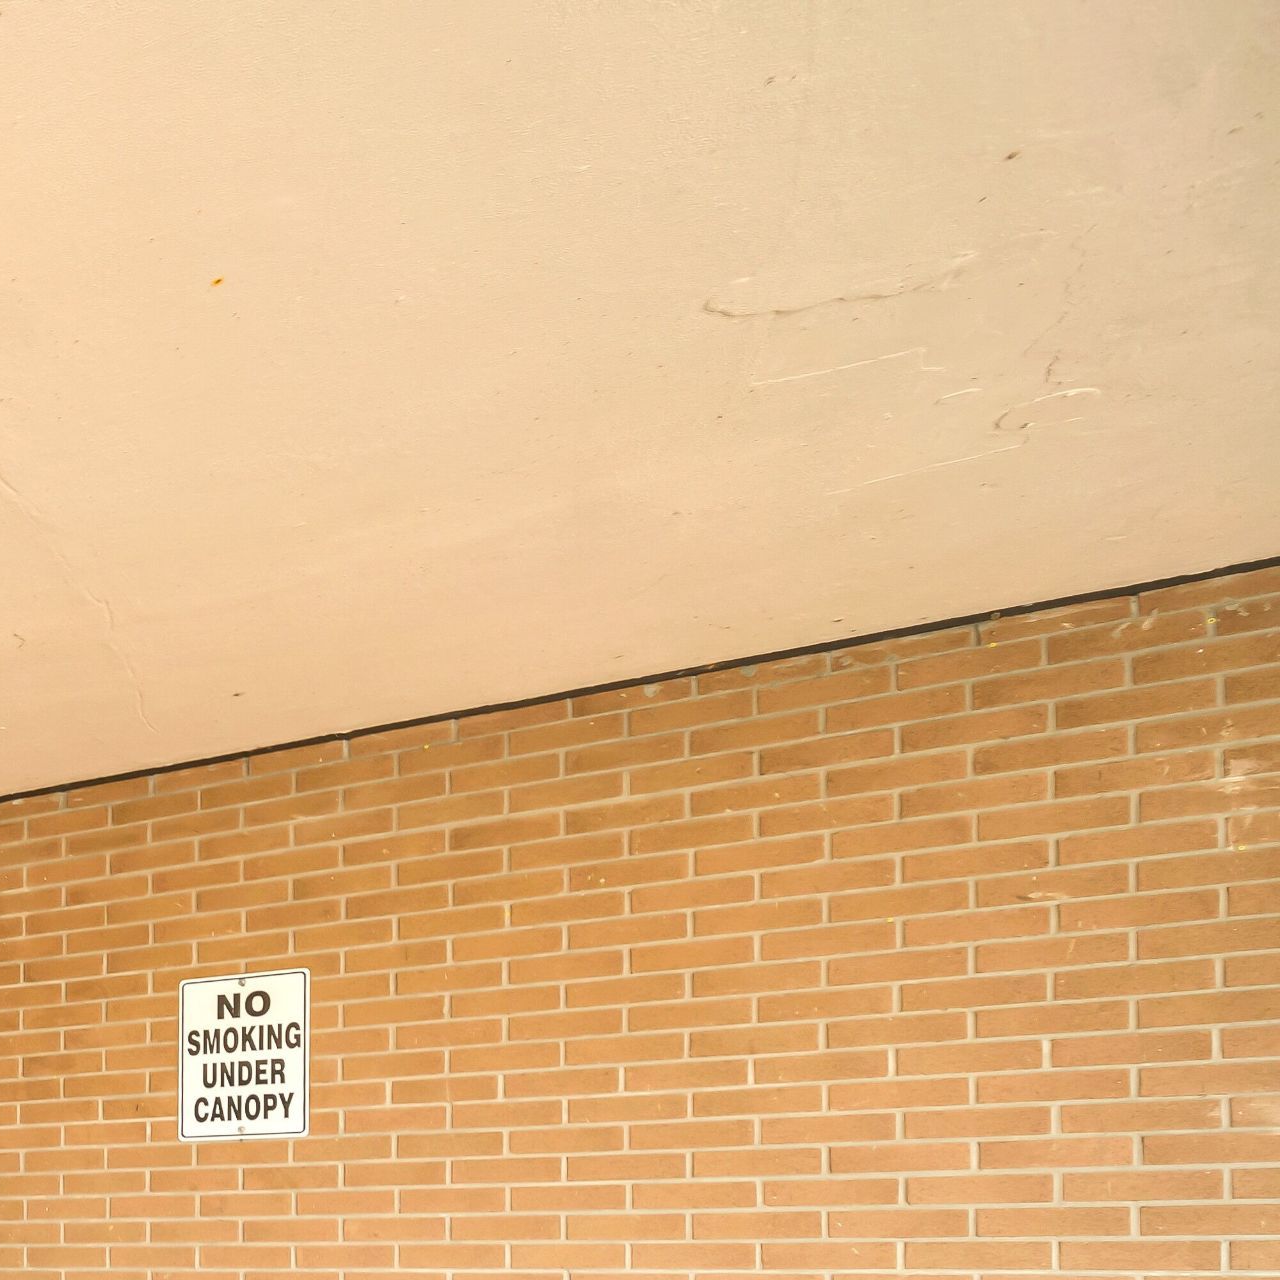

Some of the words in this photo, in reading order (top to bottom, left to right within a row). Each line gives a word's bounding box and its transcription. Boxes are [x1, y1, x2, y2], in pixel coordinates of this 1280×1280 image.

[217, 990, 271, 1020] NO
[187, 1022, 301, 1056] SMOKING
[203, 1058, 286, 1088] UNDER
[194, 1092, 294, 1122] CANOPY
